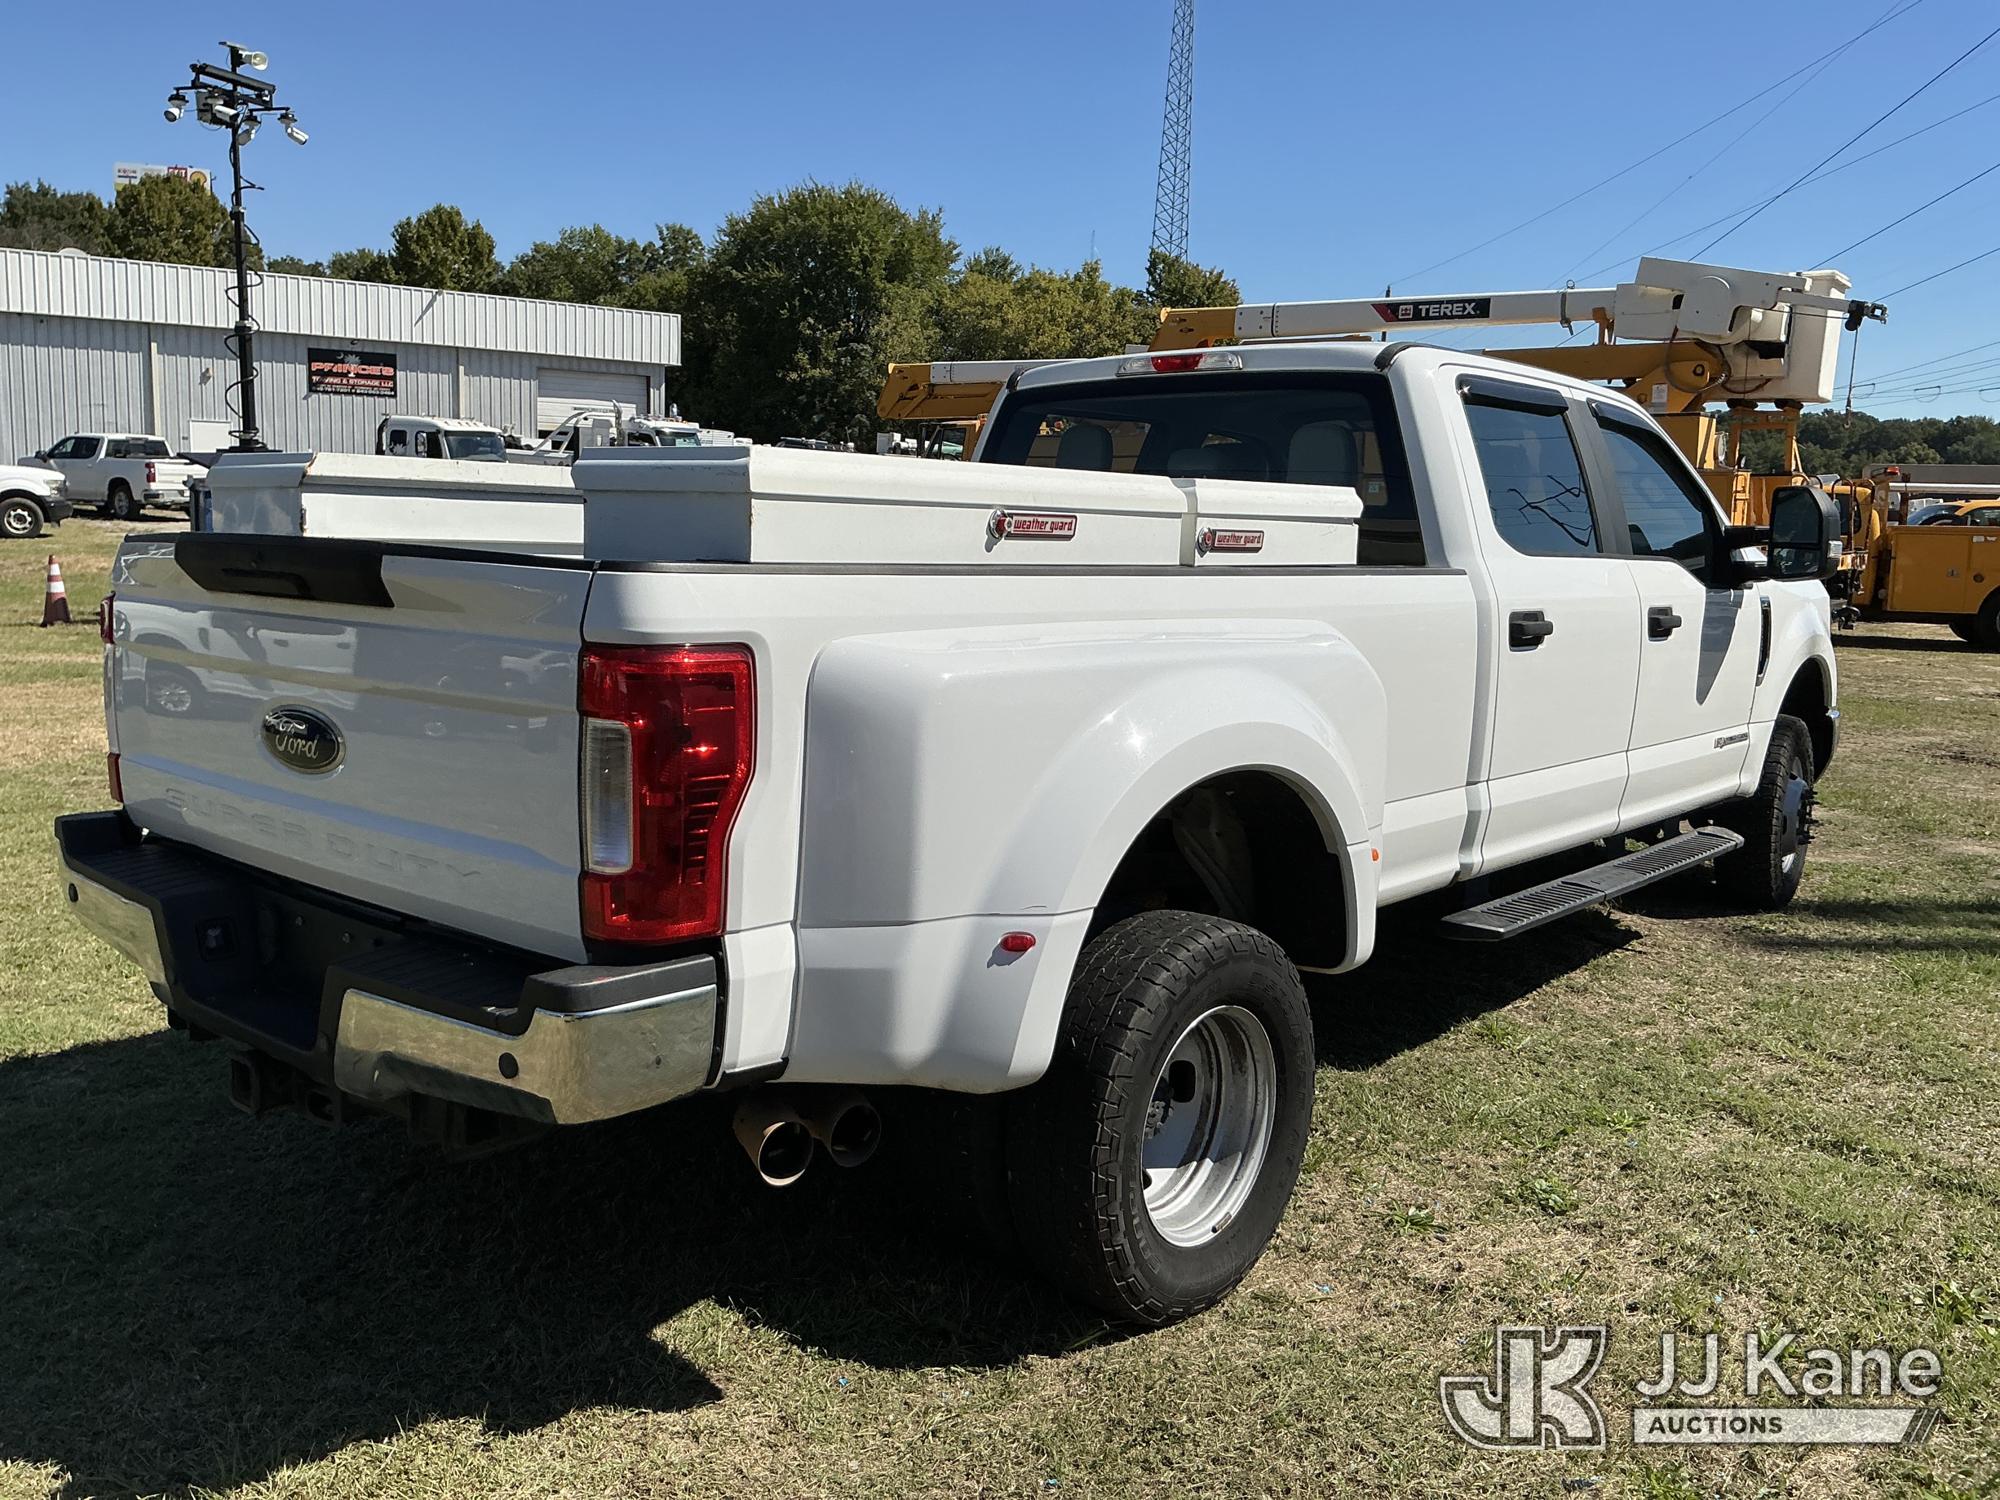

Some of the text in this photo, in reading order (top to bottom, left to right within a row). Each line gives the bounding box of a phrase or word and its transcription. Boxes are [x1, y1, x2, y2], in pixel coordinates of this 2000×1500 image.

[1419, 303, 1476, 317] TEREX
[349, 378, 380, 386] STORAGE
[1014, 518, 1073, 532] weather guard
[1217, 533, 1261, 545] weather guard
[275, 717, 320, 759] Ford
[165, 787, 482, 886] SUPER DUTY
